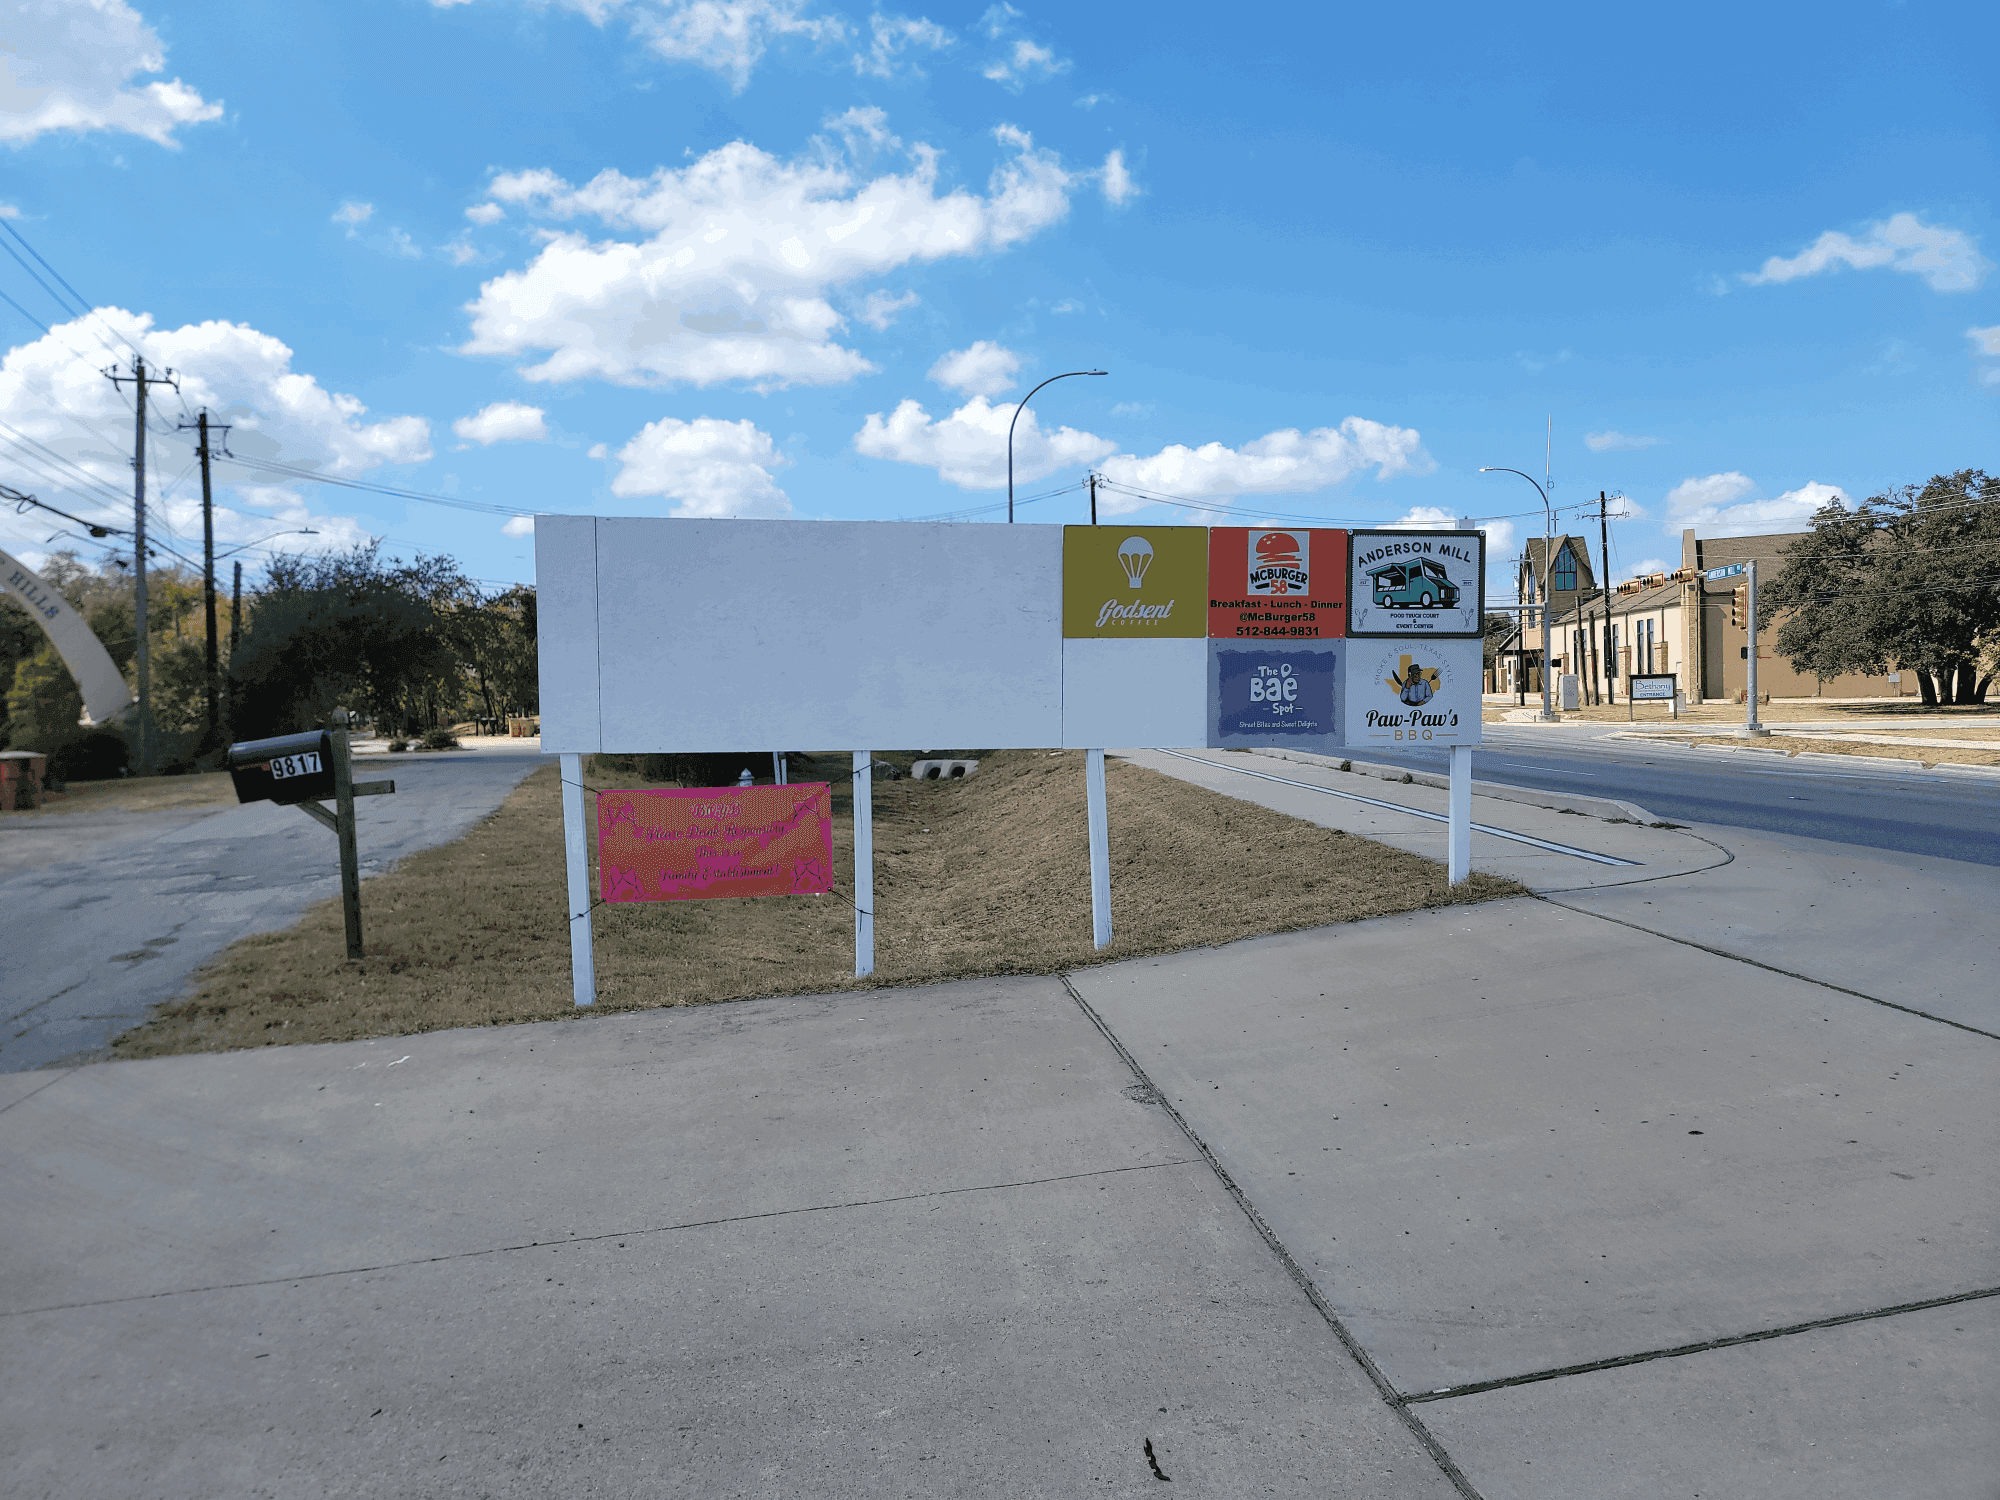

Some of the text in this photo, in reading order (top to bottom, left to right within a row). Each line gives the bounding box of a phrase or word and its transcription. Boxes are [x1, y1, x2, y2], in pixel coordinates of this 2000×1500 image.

[1358, 542, 1471, 568] ANDERSON MILL
[1249, 568, 1308, 584] MCBURGER
[1270, 579, 1288, 594] 58
[1210, 599, 1261, 608] Breakfast
[1270, 600, 1302, 609] Lunch
[1310, 600, 1343, 609] Dinner
[1095, 598, 1175, 627] Godsent
[1239, 612, 1316, 623] @McBurger58
[1236, 626, 1319, 636] 512-844-9831
[1257, 665, 1279, 678] The
[1375, 659, 1388, 685] SMOKE
[1420, 644, 1443, 660] TEXAS
[1442, 660, 1454, 683] STYLE
[1250, 677, 1299, 702] Bae
[1635, 680, 1671, 691] Bethany
[1272, 703, 1294, 715] Spot
[1298, 721, 1318, 729] Delights
[1366, 709, 1458, 727] Paw-Paw's
[1394, 729, 1433, 741] BBQ
[272, 753, 318, 778] 9817
[658, 867, 699, 884] Family
